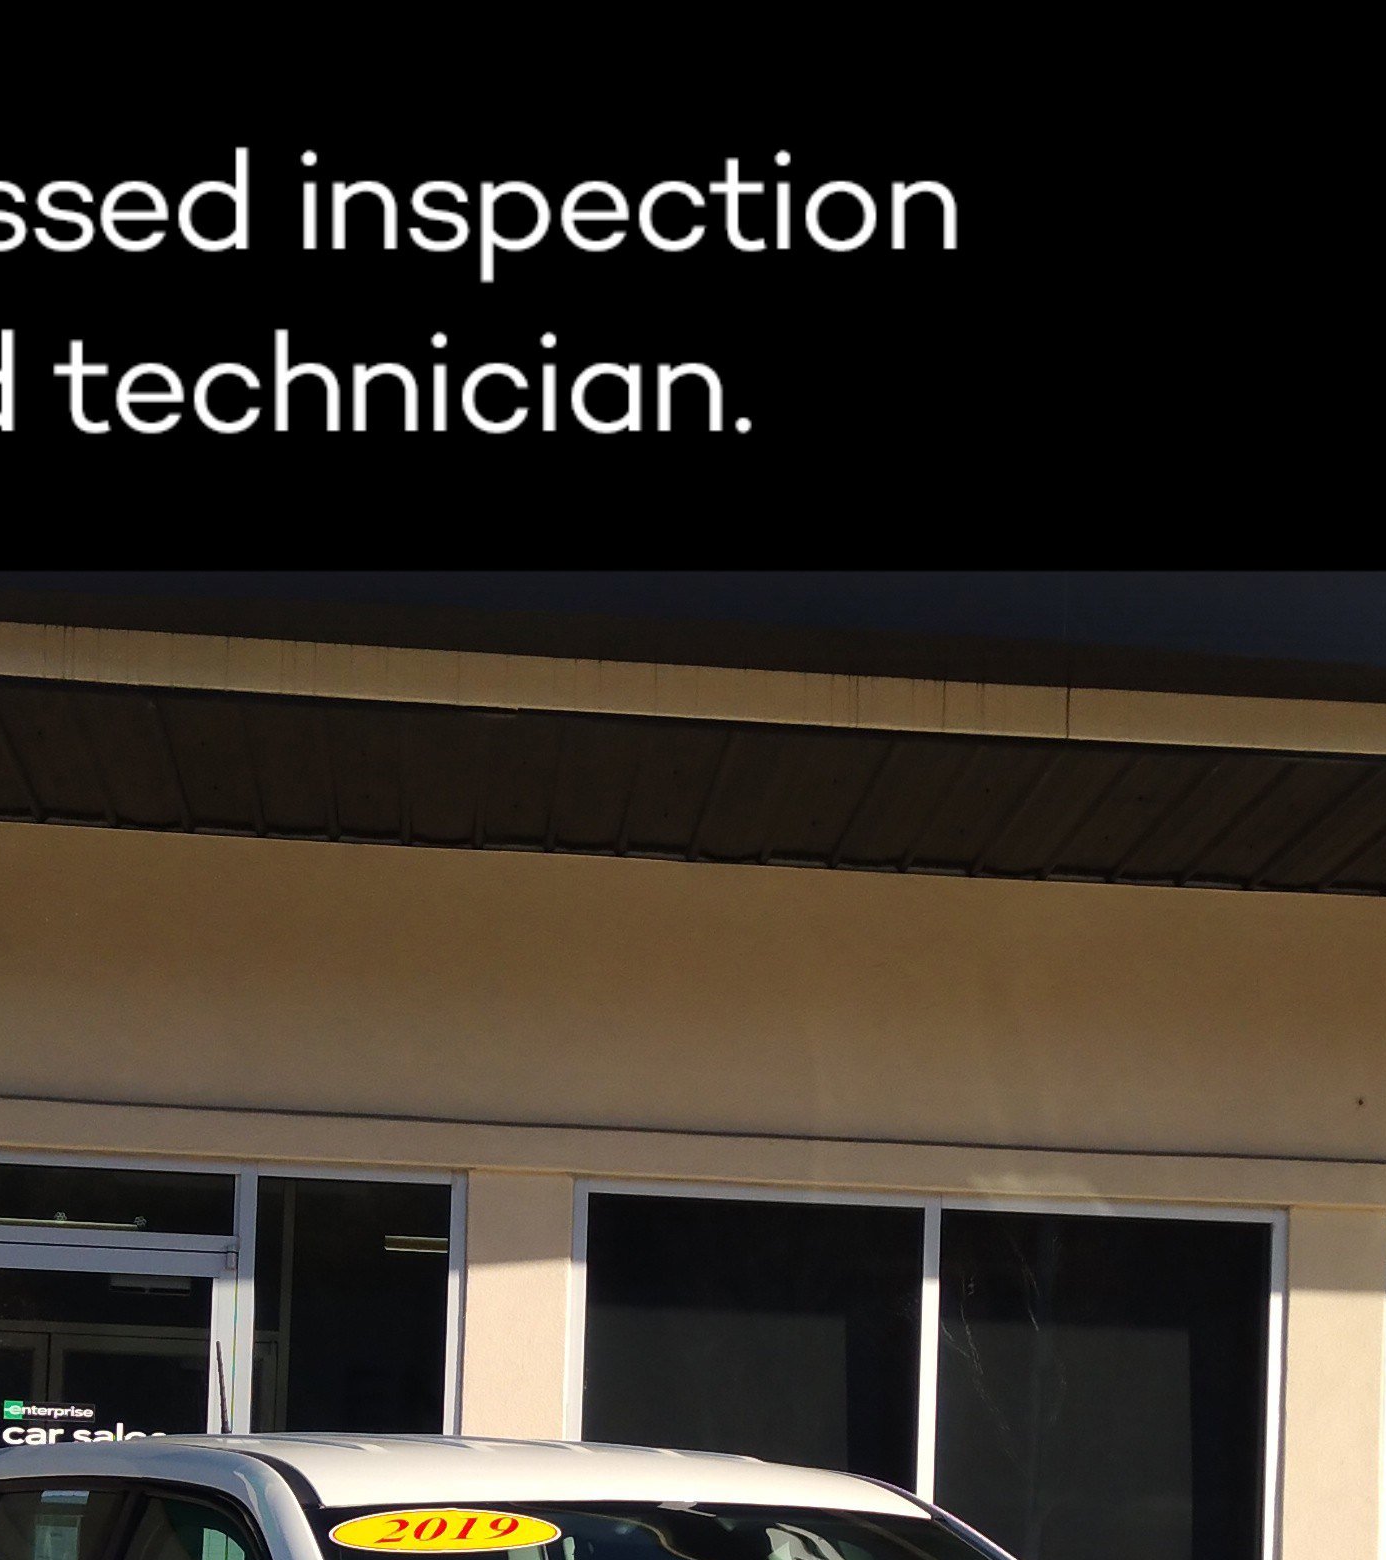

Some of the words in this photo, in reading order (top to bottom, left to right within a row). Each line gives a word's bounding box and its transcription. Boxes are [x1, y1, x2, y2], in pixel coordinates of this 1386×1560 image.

[6, 1404, 93, 1419] enterprise
[2, 1427, 64, 1445] car
[72, 1422, 167, 1444] sal
[374, 1516, 520, 1543] 2019
